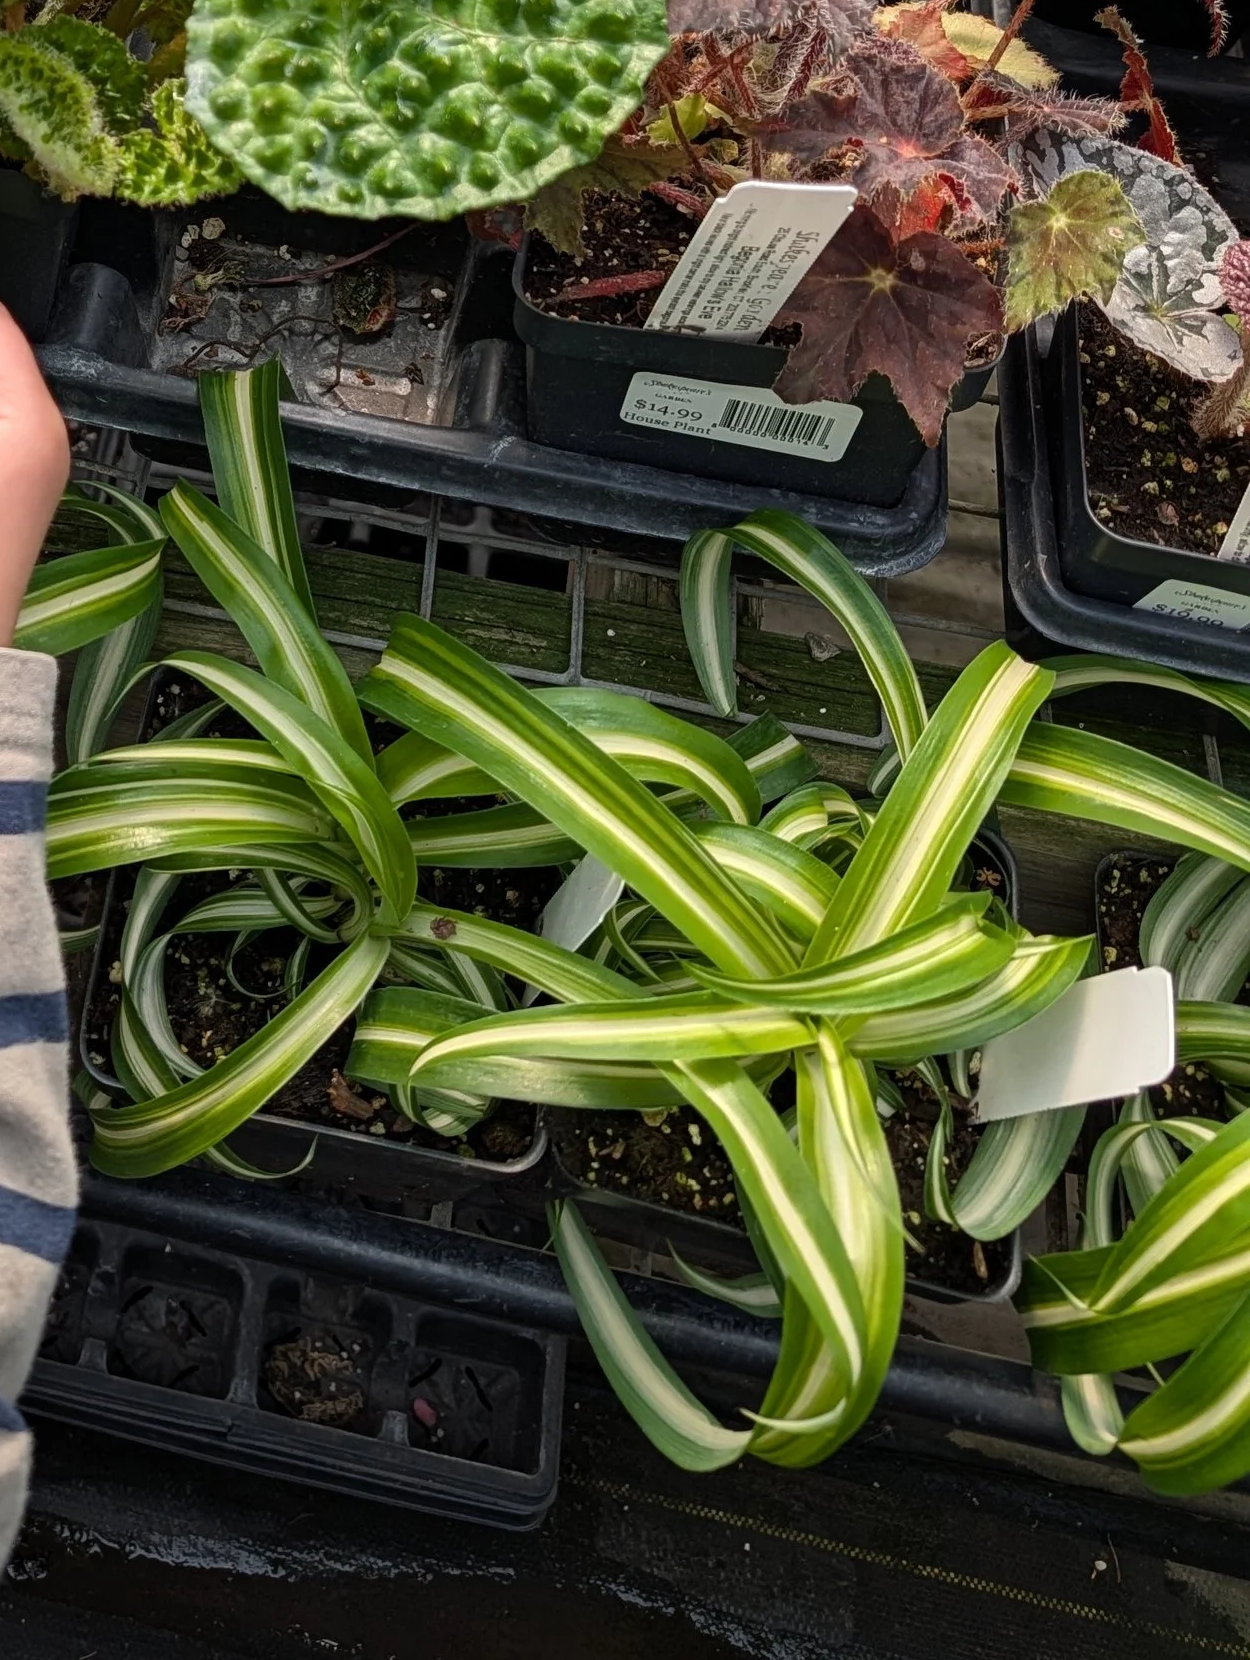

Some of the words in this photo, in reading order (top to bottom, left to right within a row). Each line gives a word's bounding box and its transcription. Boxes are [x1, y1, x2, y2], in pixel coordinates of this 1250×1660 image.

[725, 246, 760, 276] Begonia
[698, 305, 722, 320] Eve
[633, 398, 703, 422] $14.99
[623, 411, 670, 427] House
[672, 421, 712, 435] Plant
